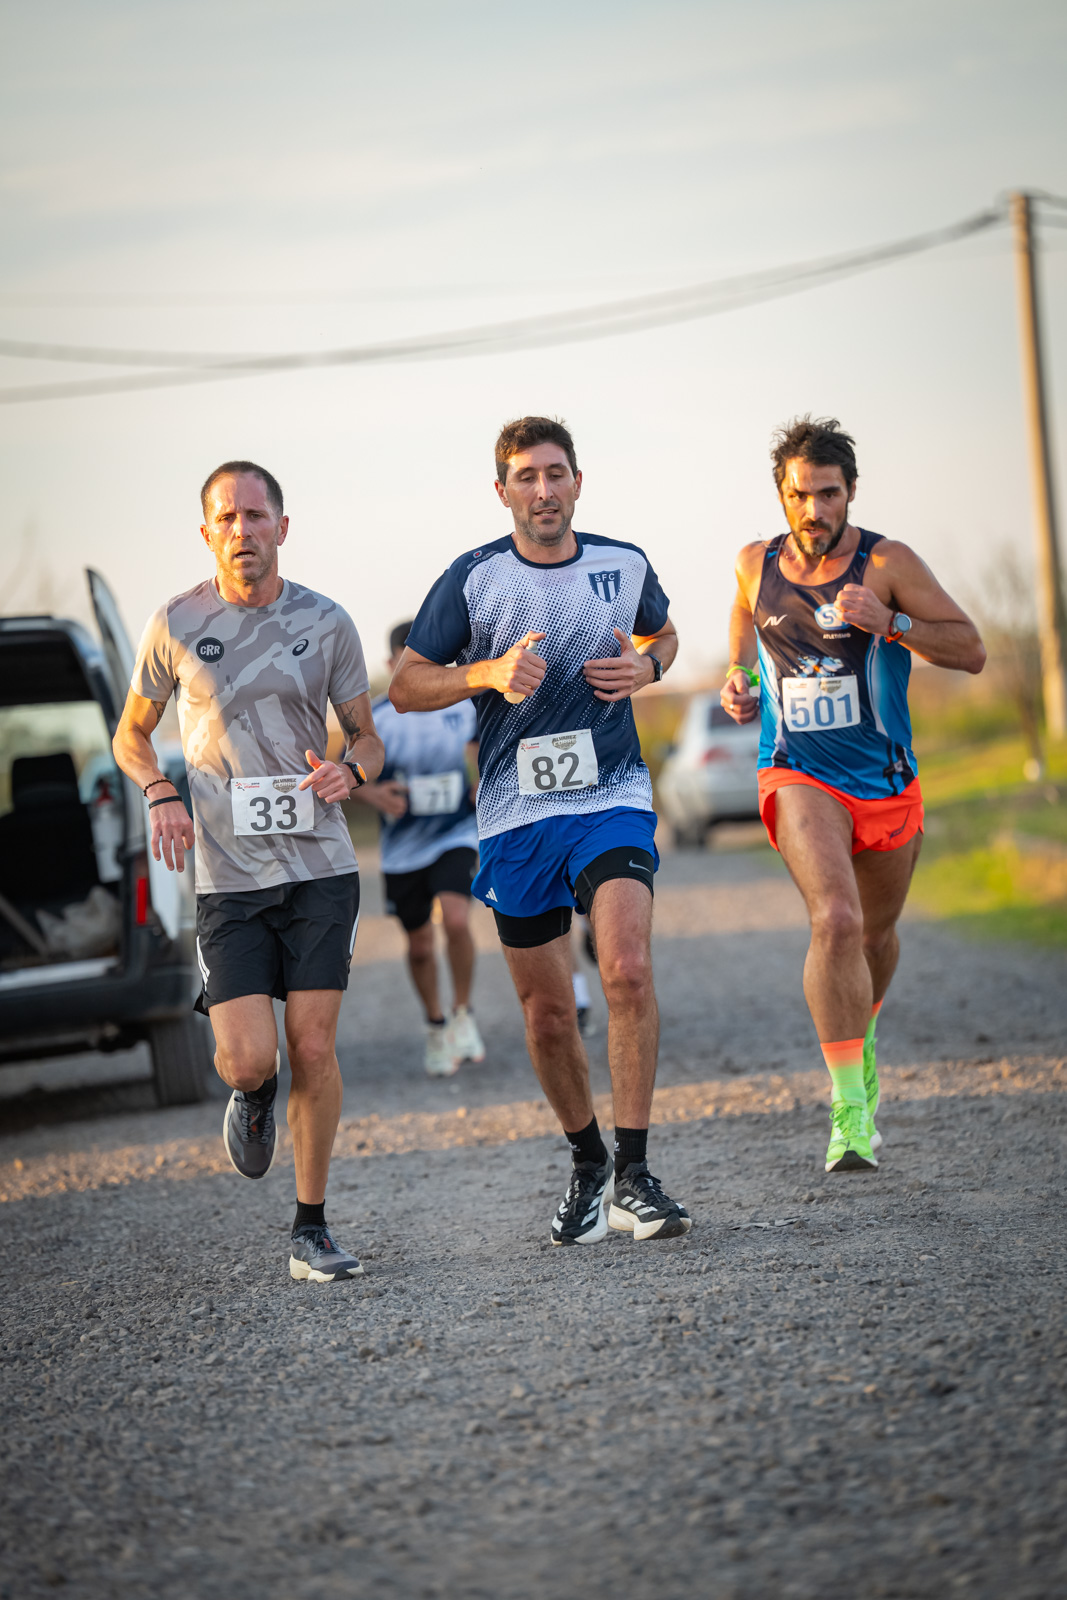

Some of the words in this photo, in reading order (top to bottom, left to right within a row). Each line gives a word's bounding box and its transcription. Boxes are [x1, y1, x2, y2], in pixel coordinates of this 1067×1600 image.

[594, 573, 615, 582] SFC
[200, 644, 220, 656] CRR
[790, 693, 853, 728] 501
[531, 752, 583, 790] 82
[249, 794, 298, 832] 33
